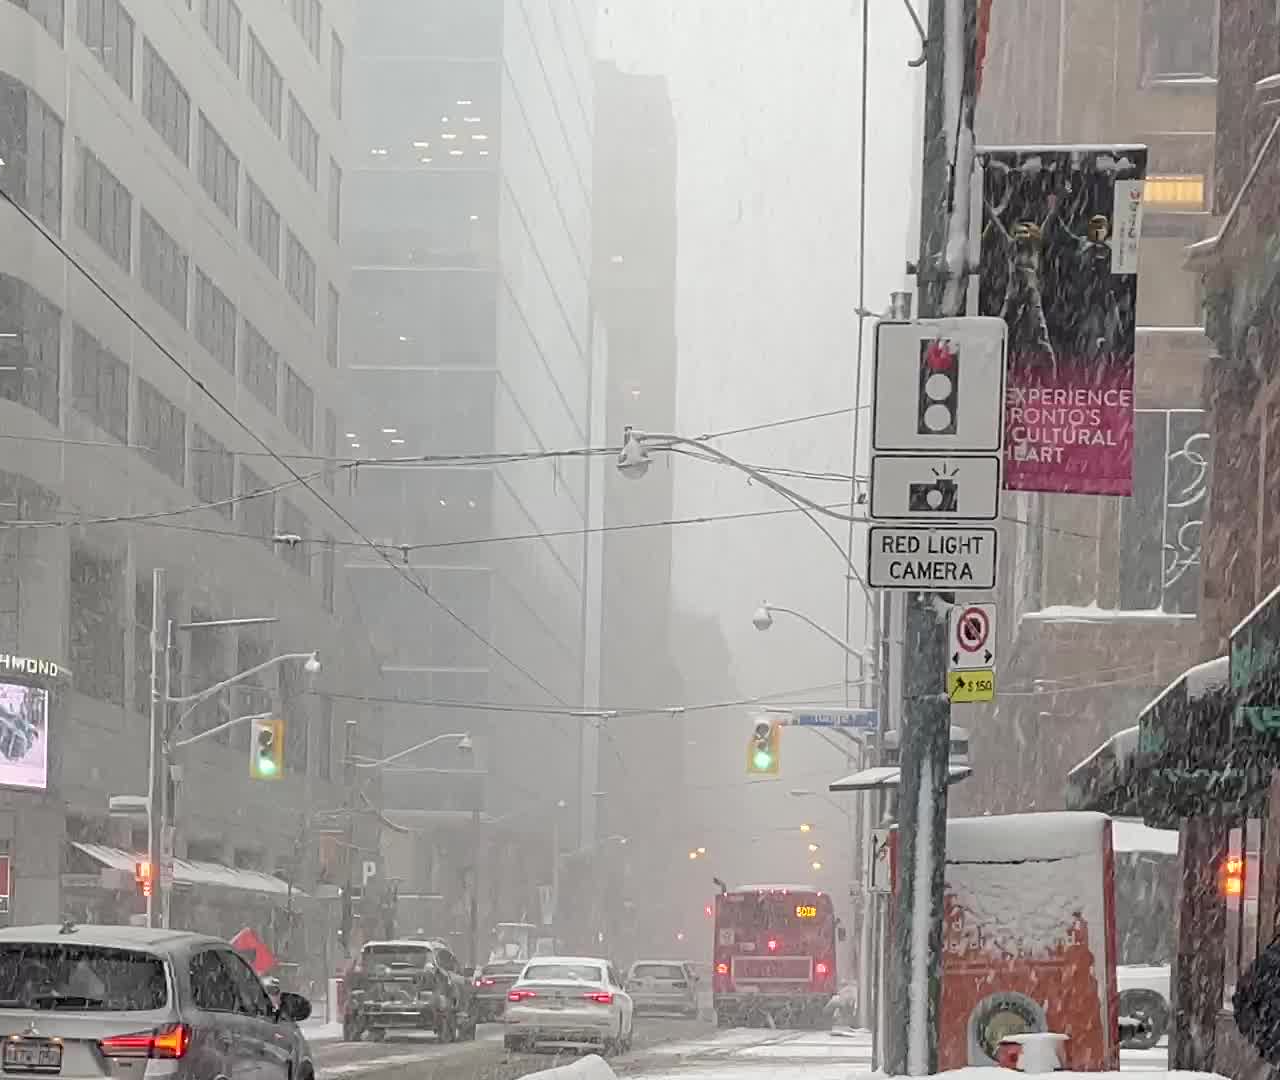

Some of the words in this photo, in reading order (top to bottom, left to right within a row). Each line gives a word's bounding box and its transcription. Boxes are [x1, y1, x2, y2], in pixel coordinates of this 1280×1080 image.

[1006, 387, 1132, 407] EXPERIENCE
[1007, 407, 1102, 426] RONTO'S
[1012, 426, 1117, 446] CULTURAL
[881, 535, 921, 554] RED
[927, 535, 985, 554] LIGHT
[889, 561, 974, 582] CAMERA
